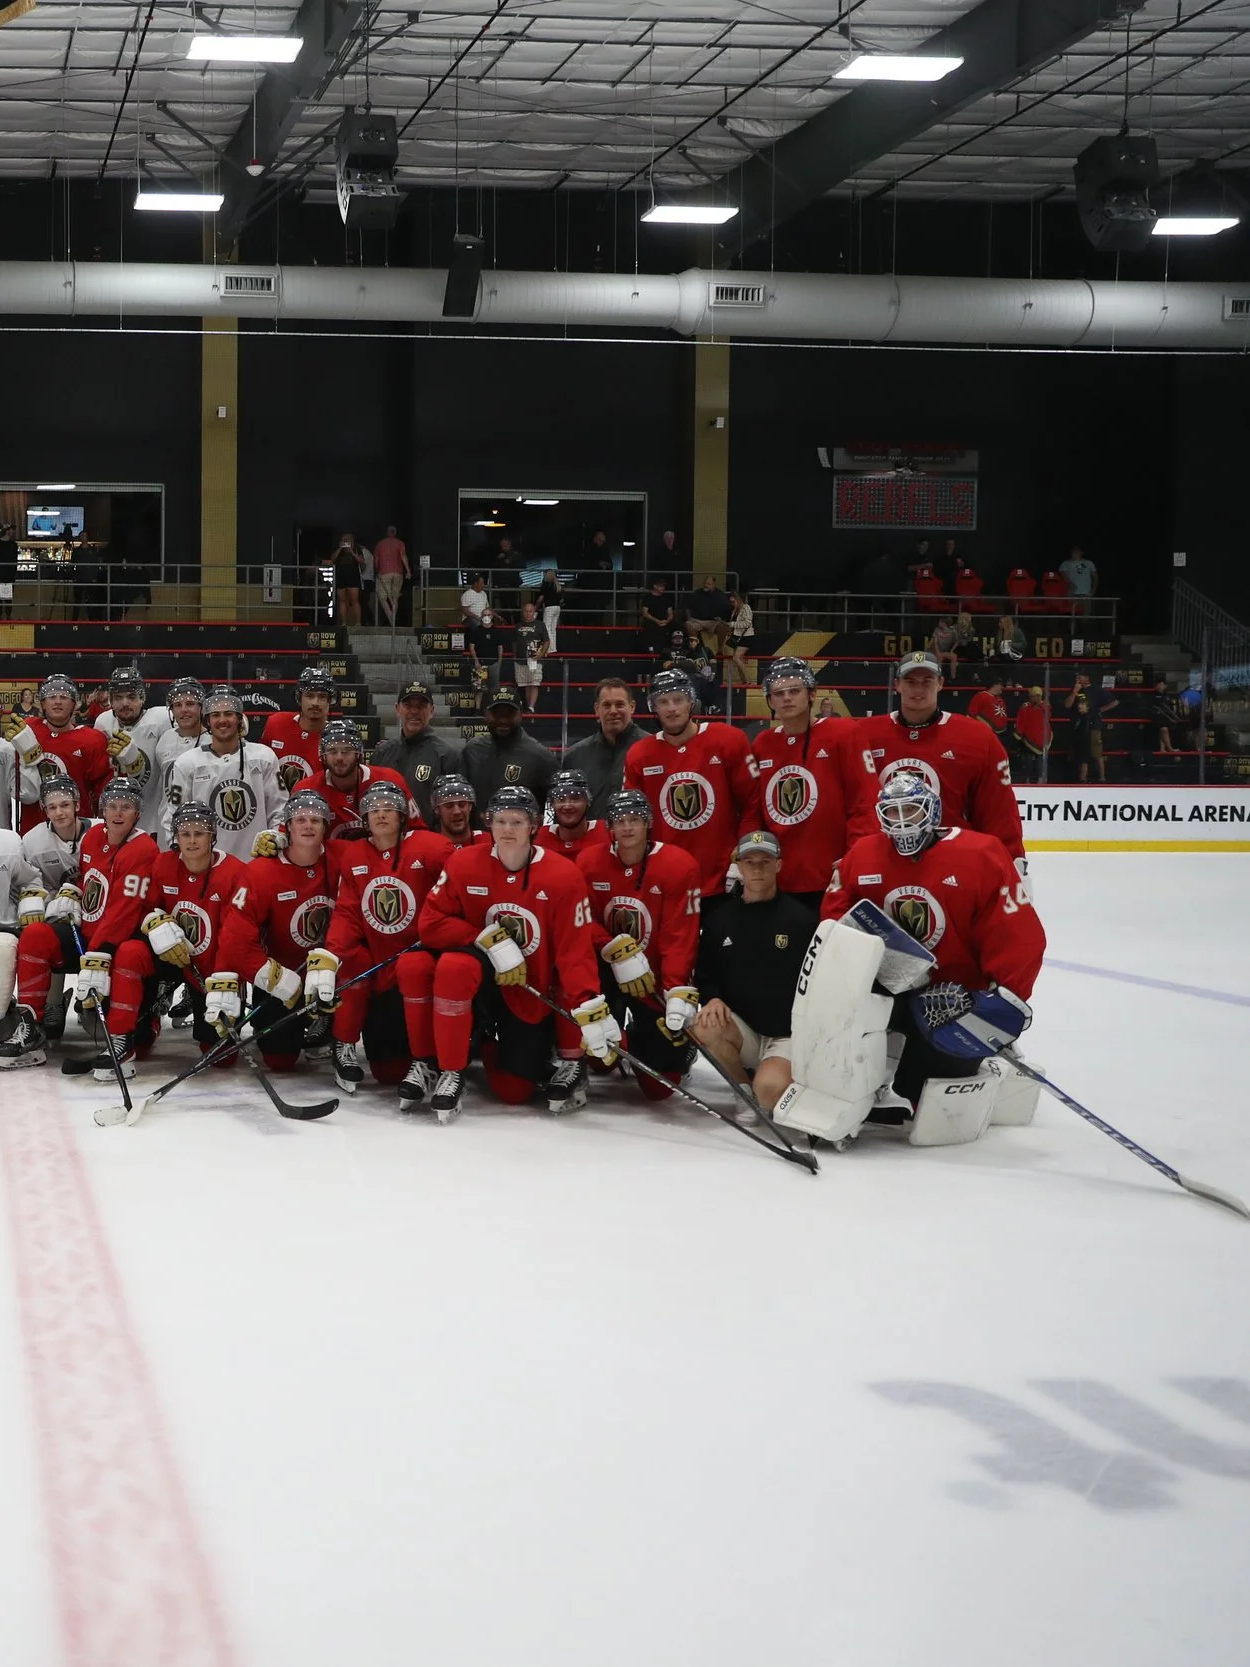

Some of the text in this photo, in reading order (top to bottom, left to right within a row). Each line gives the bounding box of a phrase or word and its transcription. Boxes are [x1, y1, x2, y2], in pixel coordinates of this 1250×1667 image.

[838, 480, 973, 523] REBELS
[883, 636, 913, 656] GO
[1035, 638, 1064, 657] GO
[778, 766, 802, 777] VEGAS
[896, 759, 924, 770] VEGAS
[220, 780, 241, 790] VEGAS
[669, 772, 696, 783] VEGAS
[1063, 800, 1184, 822] NATIONAL
[374, 876, 397, 887] VEGAS
[232, 887, 248, 910] 4
[897, 886, 928, 897] VEGAS
[1000, 881, 1033, 914] 34
[148, 914, 175, 931] CC
[854, 907, 890, 943] LEFEVRE
[610, 943, 638, 960] CC
[84, 959, 110, 968] CC
[798, 934, 823, 997] CCM
[211, 981, 239, 991] CC
[943, 1081, 986, 1096] CCM
